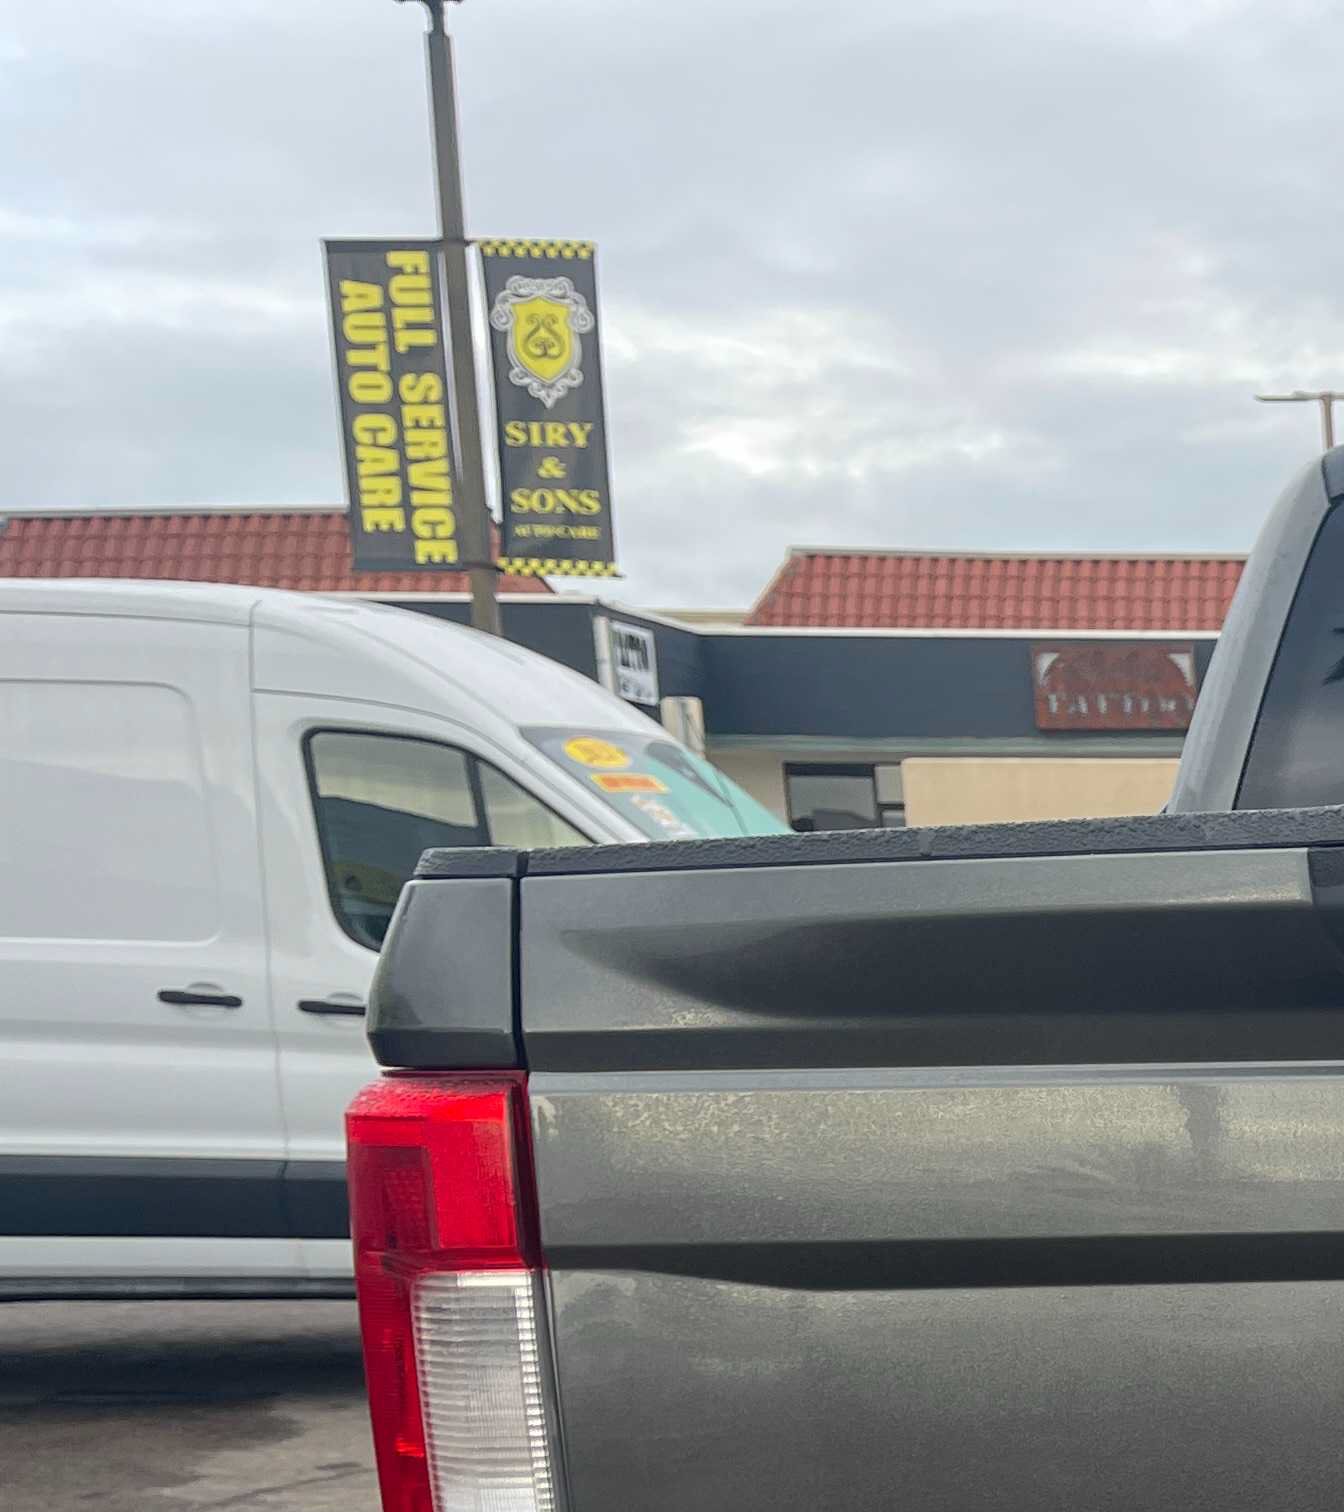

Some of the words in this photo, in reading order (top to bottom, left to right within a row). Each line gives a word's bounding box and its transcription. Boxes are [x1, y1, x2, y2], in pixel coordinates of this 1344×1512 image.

[339, 280, 393, 404] AUTO
[386, 250, 436, 354] FULL
[352, 413, 406, 533] CARE
[399, 372, 458, 565] SERVICE
[504, 421, 593, 449] SIRY
[536, 456, 567, 479] &
[510, 488, 601, 515] SONS
